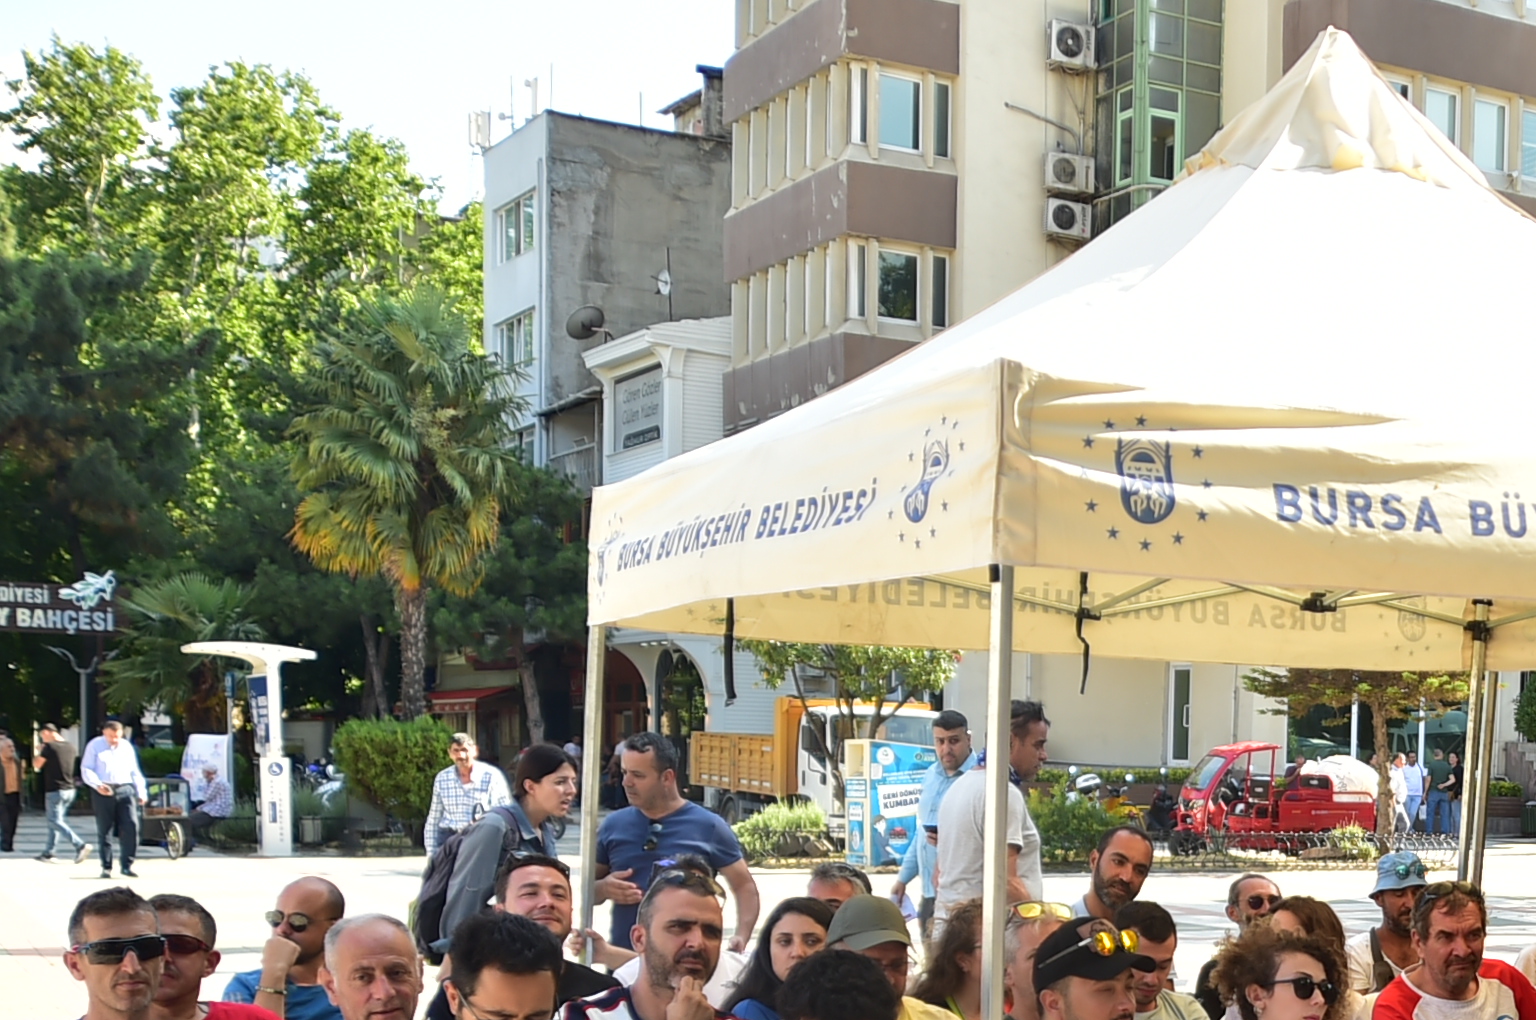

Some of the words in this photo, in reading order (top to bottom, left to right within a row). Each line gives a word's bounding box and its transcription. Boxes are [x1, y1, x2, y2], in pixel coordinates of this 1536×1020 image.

[617, 538, 652, 572] BURSA
[656, 502, 753, 560] BÜYÜKŞEHİR
[754, 477, 878, 540] BELEDİYESİ
[1272, 482, 1443, 535] BURSA
[15, 607, 115, 635] BAHÇESİ
